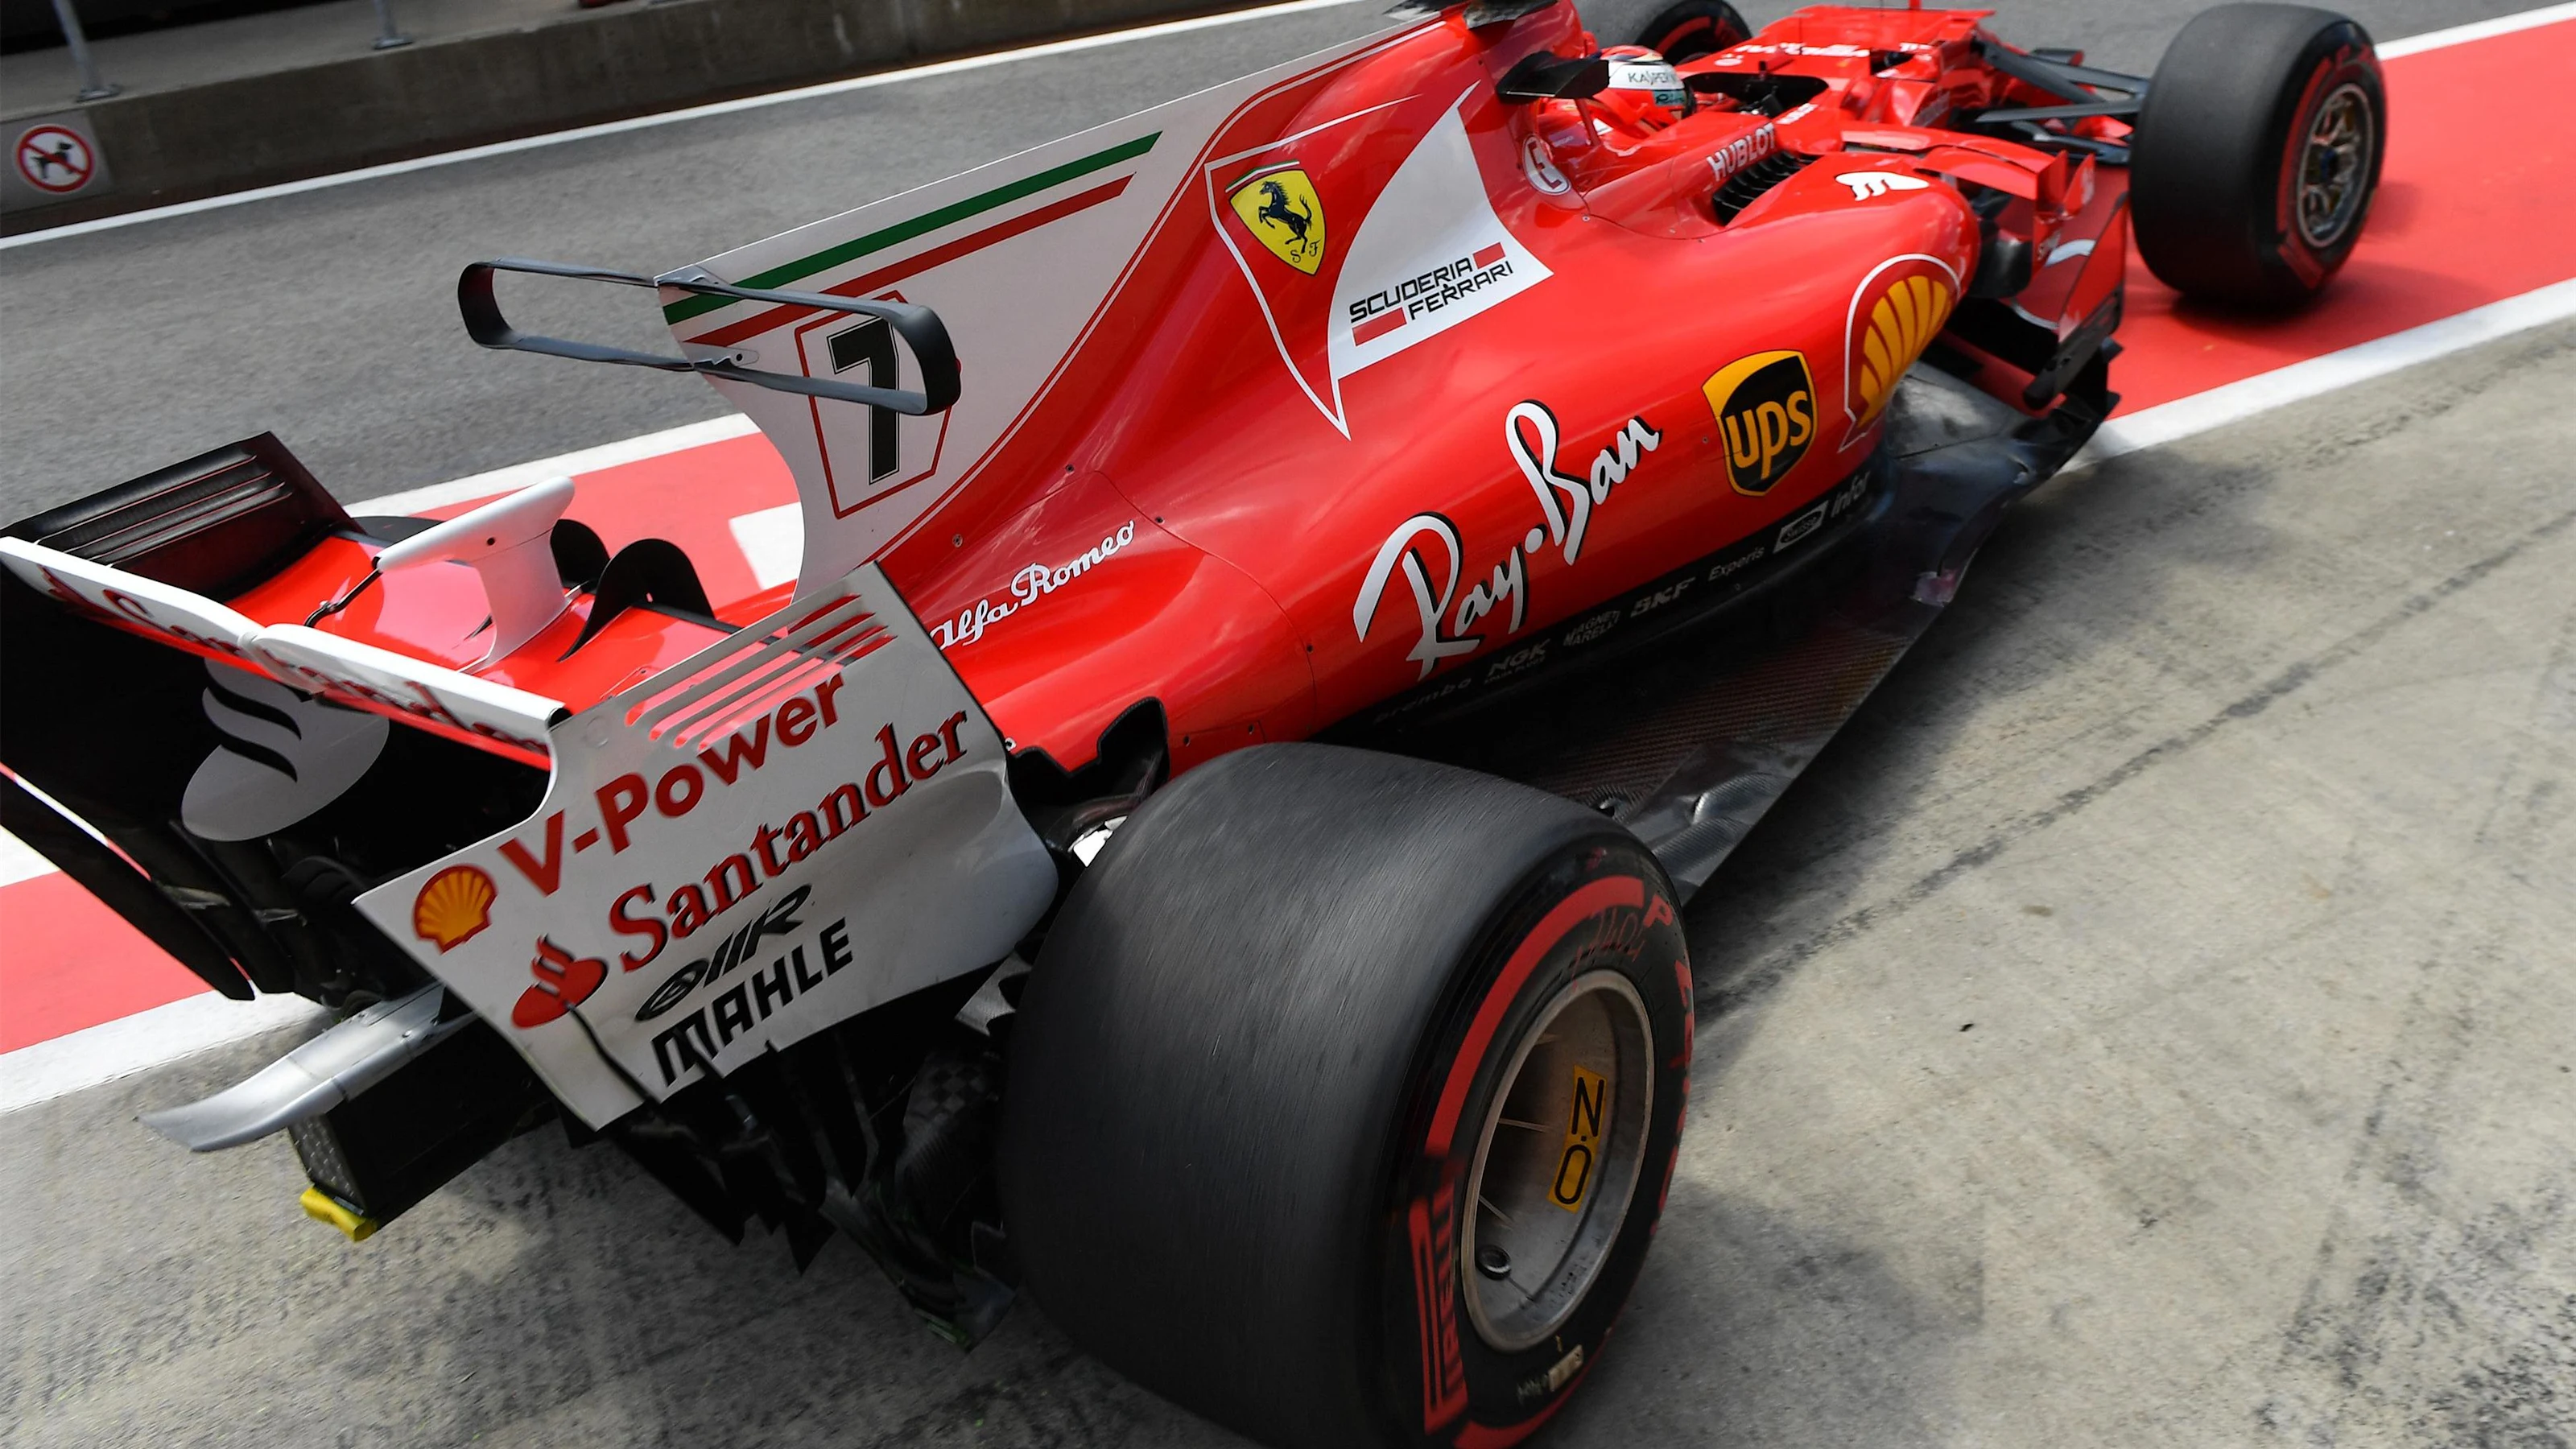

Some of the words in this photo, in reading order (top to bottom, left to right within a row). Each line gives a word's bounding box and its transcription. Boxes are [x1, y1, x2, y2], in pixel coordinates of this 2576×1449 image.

[1706, 122, 1775, 182] HUBLOT
[1290, 250, 1301, 263] S
[1309, 240, 1321, 257] F
[1349, 258, 1473, 323] SCUDERIA
[1409, 260, 1513, 320] FERRARI
[827, 316, 899, 485] 7
[1010, 519, 1136, 606] Romeo
[1707, 547, 1764, 581] Experis
[1630, 576, 1696, 618] SKF
[1488, 638, 1551, 676] NGK
[498, 671, 844, 896] V-Power
[609, 709, 968, 974] Santander
[652, 917, 853, 1087] MAHLE
